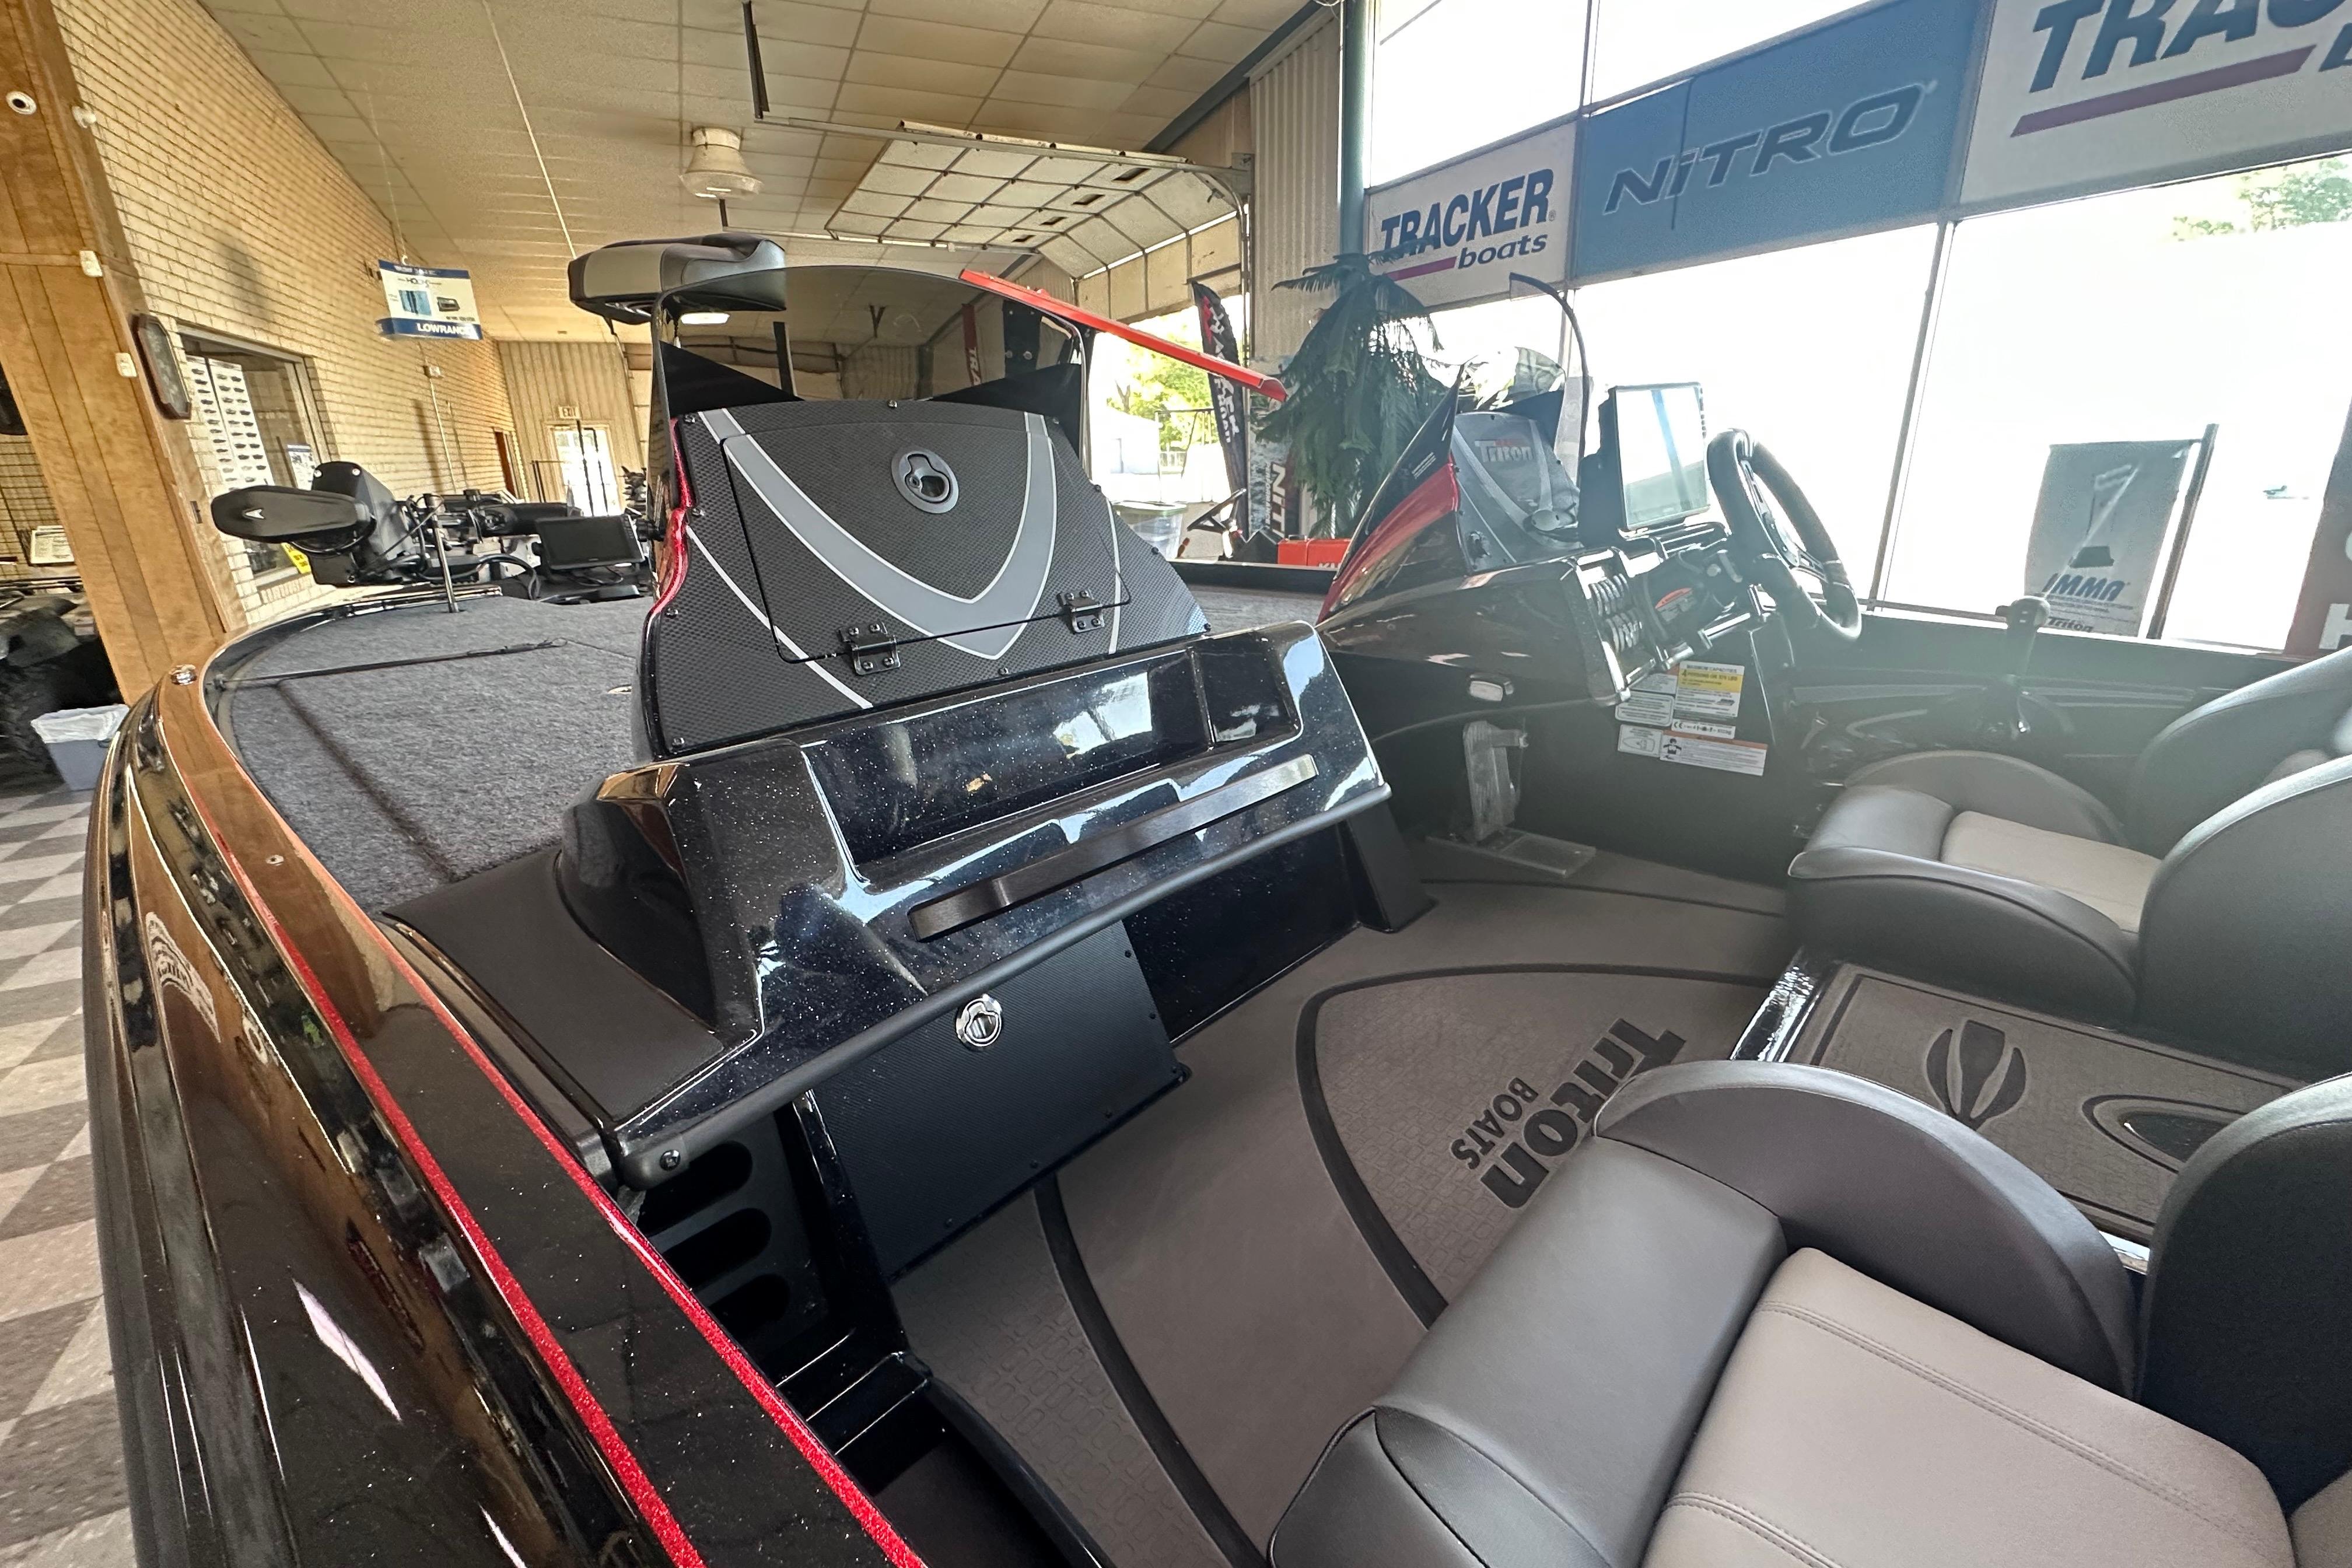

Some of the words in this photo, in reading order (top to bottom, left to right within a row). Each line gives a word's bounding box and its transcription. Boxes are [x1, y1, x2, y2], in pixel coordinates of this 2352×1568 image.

[1381, 169, 1554, 259] TRACKER
[1458, 234, 1548, 270] boats
[416, 323, 473, 337] LOWRANC
[1451, 1077, 1538, 1169] BOATS
[1480, 1018, 1686, 1208] Triton
